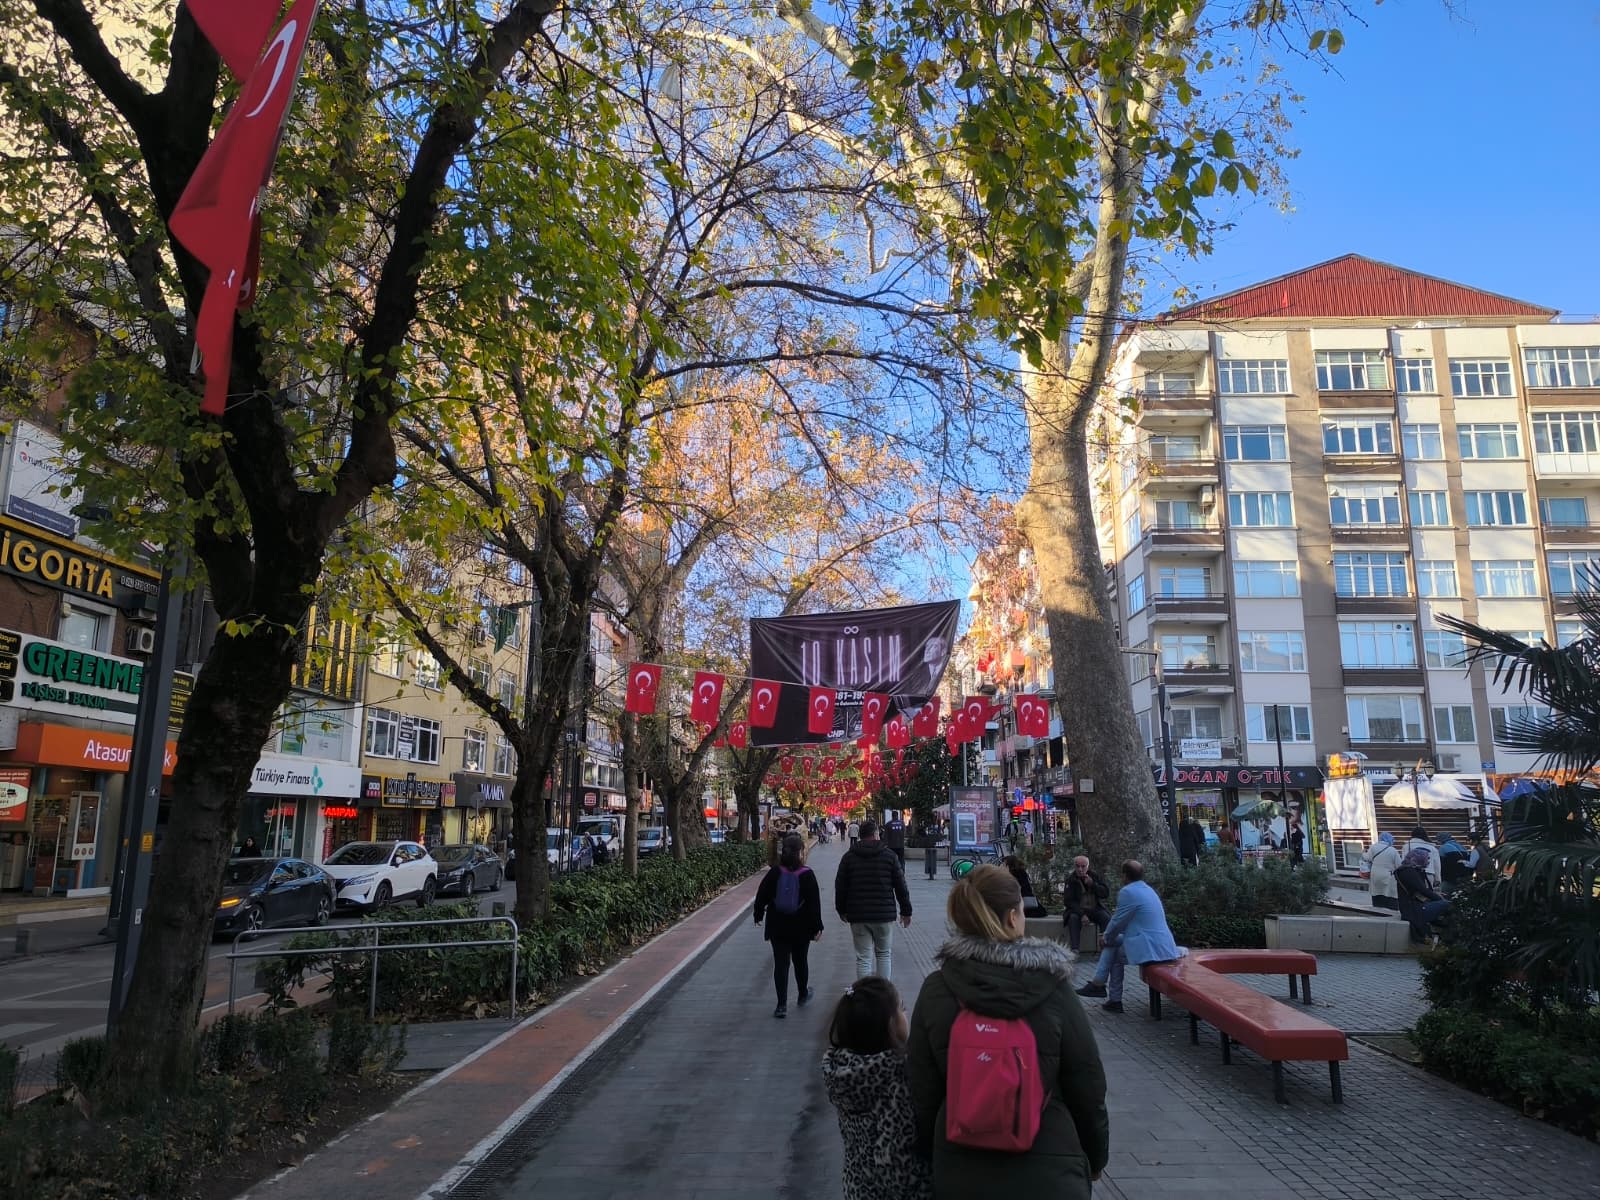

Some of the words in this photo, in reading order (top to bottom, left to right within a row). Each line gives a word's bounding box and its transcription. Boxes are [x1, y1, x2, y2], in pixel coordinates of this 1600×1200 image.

[800, 641, 821, 686] 10
[837, 635, 901, 685] KASIM
[827, 729, 845, 738] CHP
[256, 768, 285, 785] Türkiye
[286, 771, 310, 785] Finans
[1237, 767, 1292, 784] OTİK
